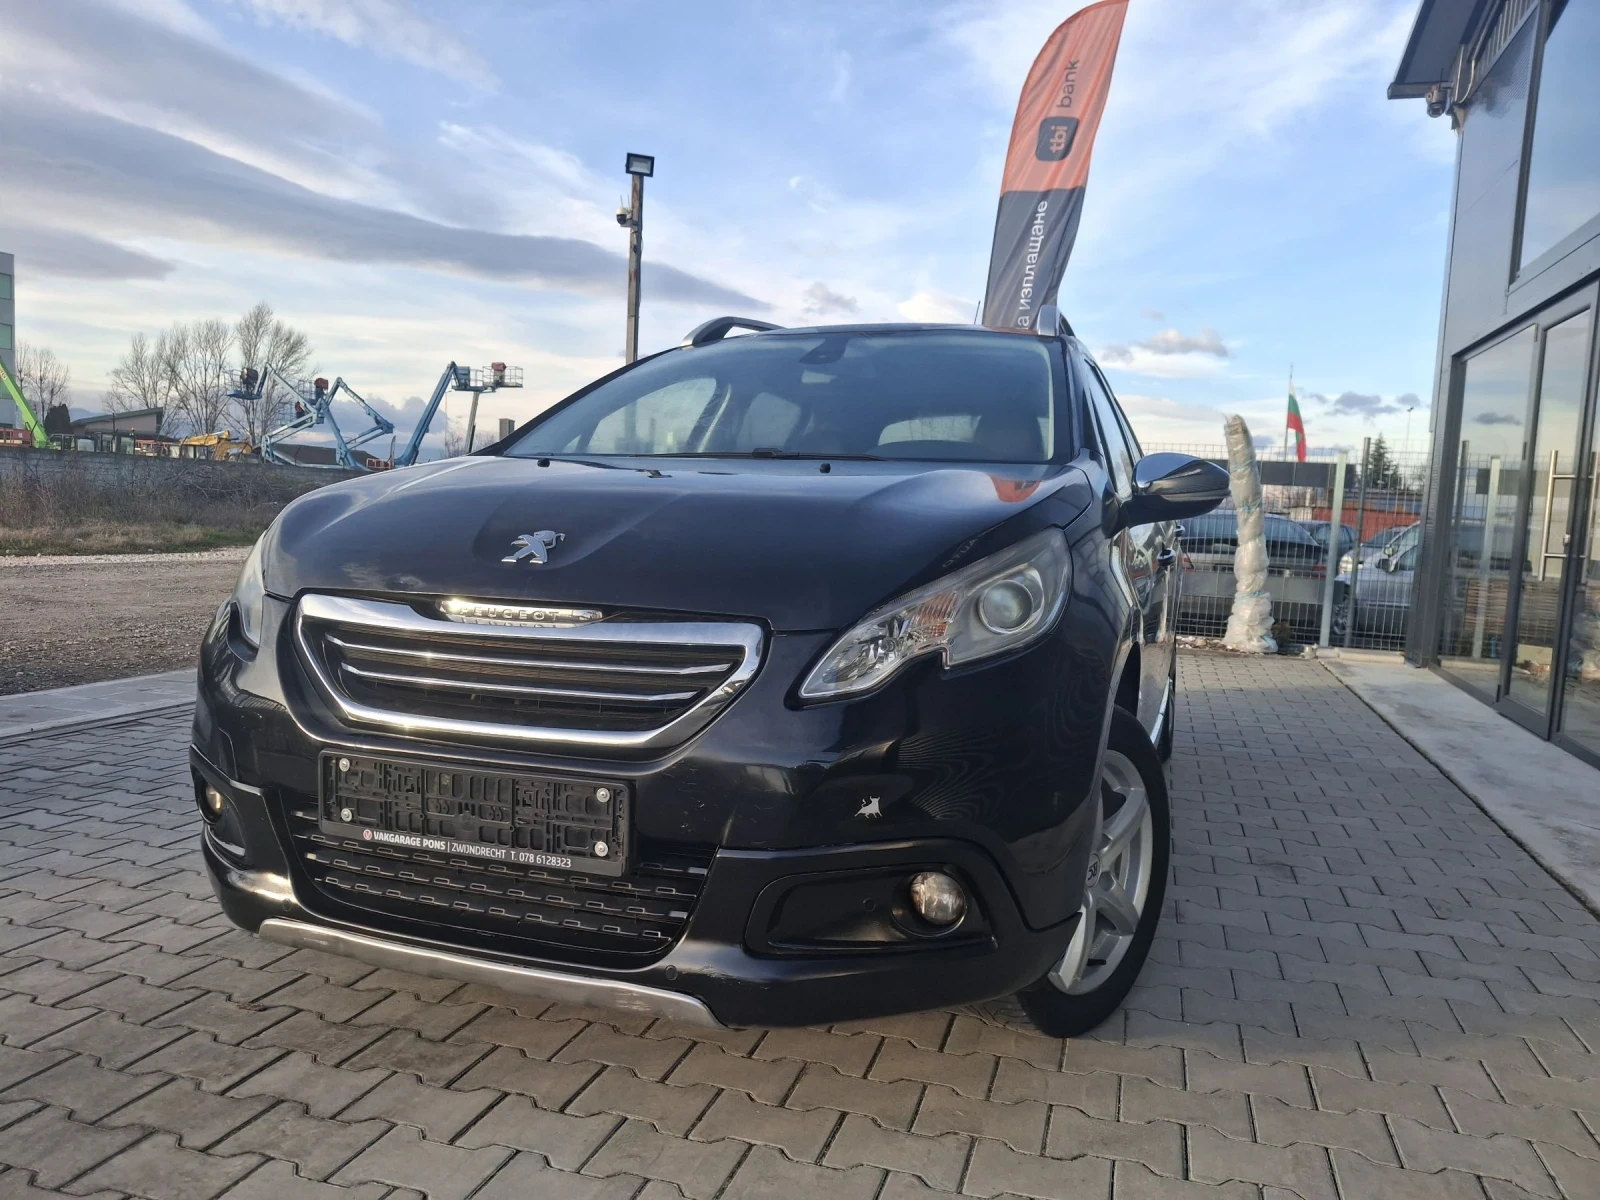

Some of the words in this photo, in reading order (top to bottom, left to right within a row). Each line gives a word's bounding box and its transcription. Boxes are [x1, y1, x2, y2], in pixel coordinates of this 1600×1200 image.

[1056, 59, 1080, 108] bank
[1050, 125, 1068, 153] tbi
[1019, 200, 1049, 310] изплащане
[459, 606, 560, 622] PEUGEOT
[373, 831, 421, 847] VAKGARAGE
[422, 839, 446, 851] PONS
[451, 842, 507, 859] ZWIJNDRECHT
[510, 850, 517, 861] T.
[519, 852, 535, 863] 078
[536, 854, 572, 868] 6128323
